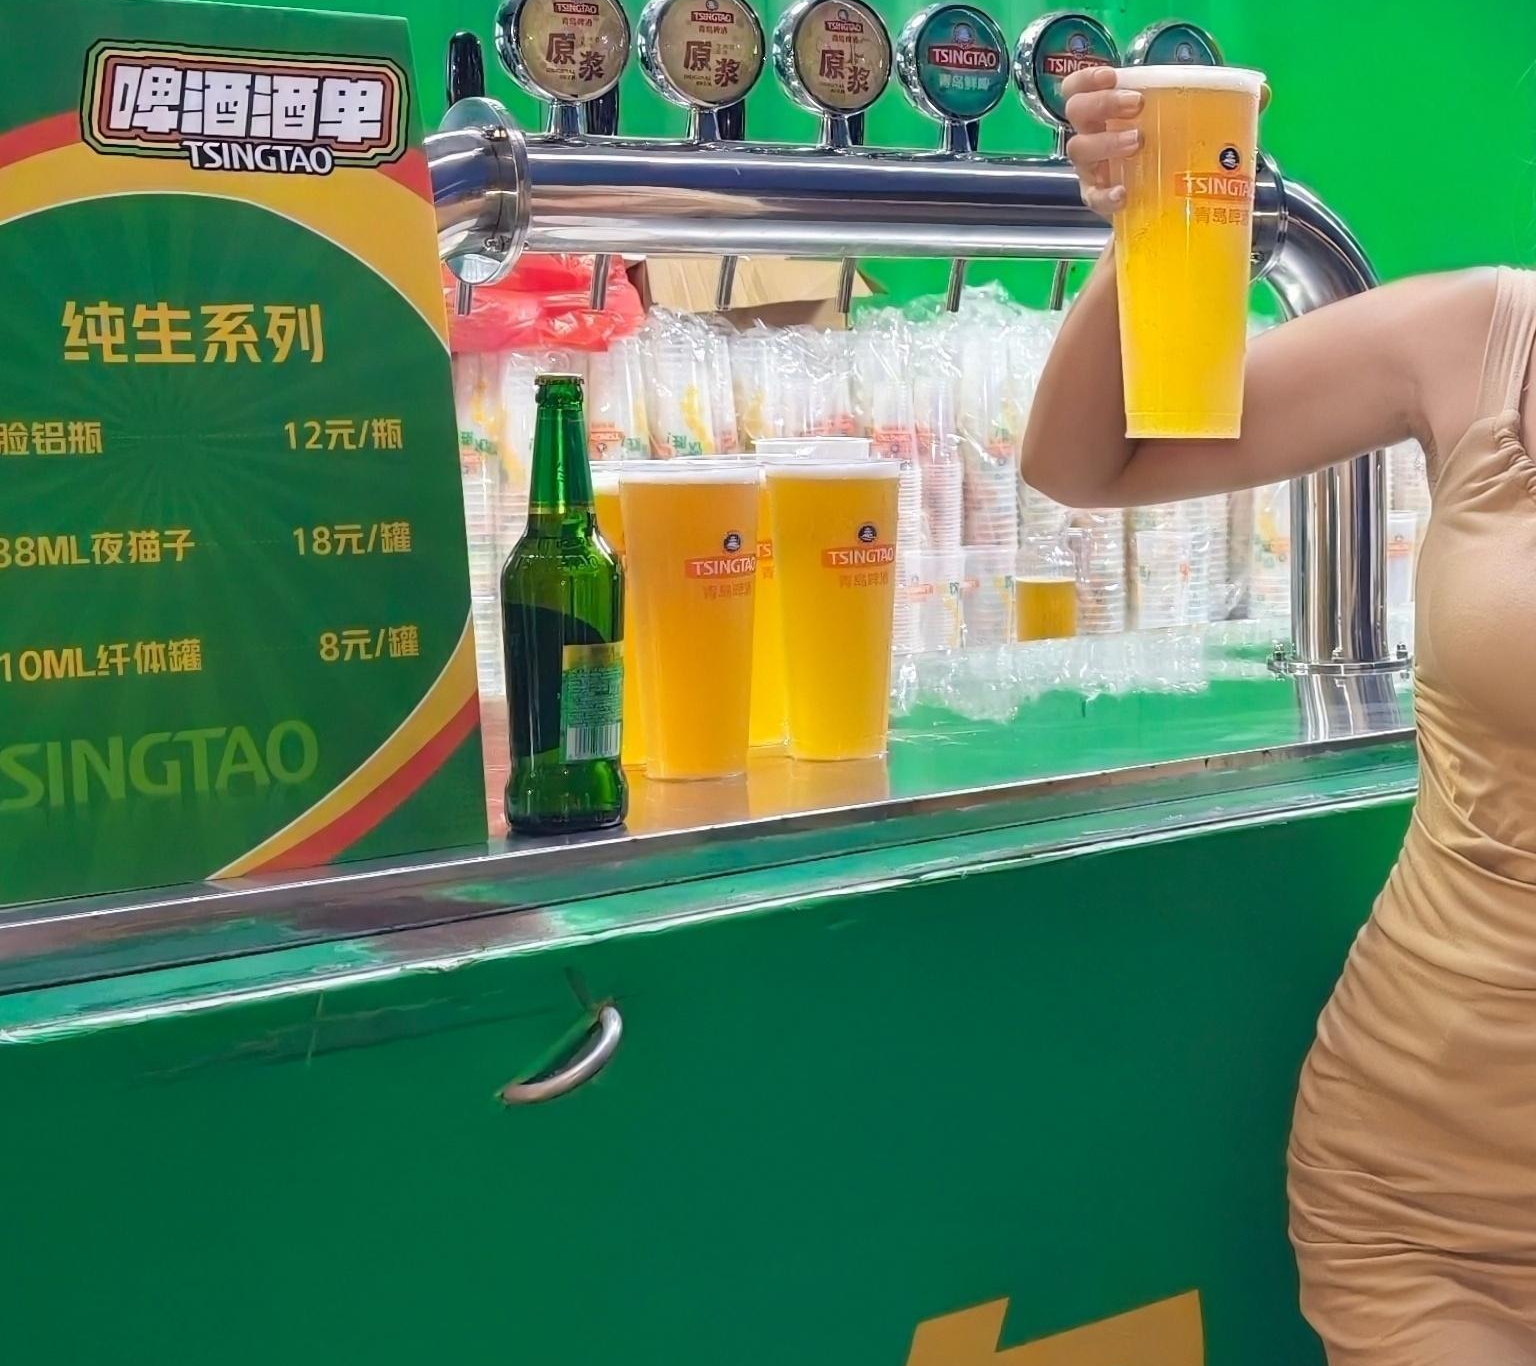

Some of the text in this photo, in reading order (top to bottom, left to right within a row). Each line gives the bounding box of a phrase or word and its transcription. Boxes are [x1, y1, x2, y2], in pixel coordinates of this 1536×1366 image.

[932, 48, 997, 67] TSINGTAO
[1047, 57, 1107, 75] TSING
[182, 140, 333, 175] TSINGTAO
[1182, 176, 1251, 198] TSINGTA
[61, 300, 325, 364] 纯生系列
[284, 418, 404, 451] 12元/瓶
[293, 521, 413, 556] 18元/罐
[692, 557, 756, 576] TSINGTAO
[828, 546, 894, 565] TSINGTAO
[319, 625, 419, 662] 8元/罐
